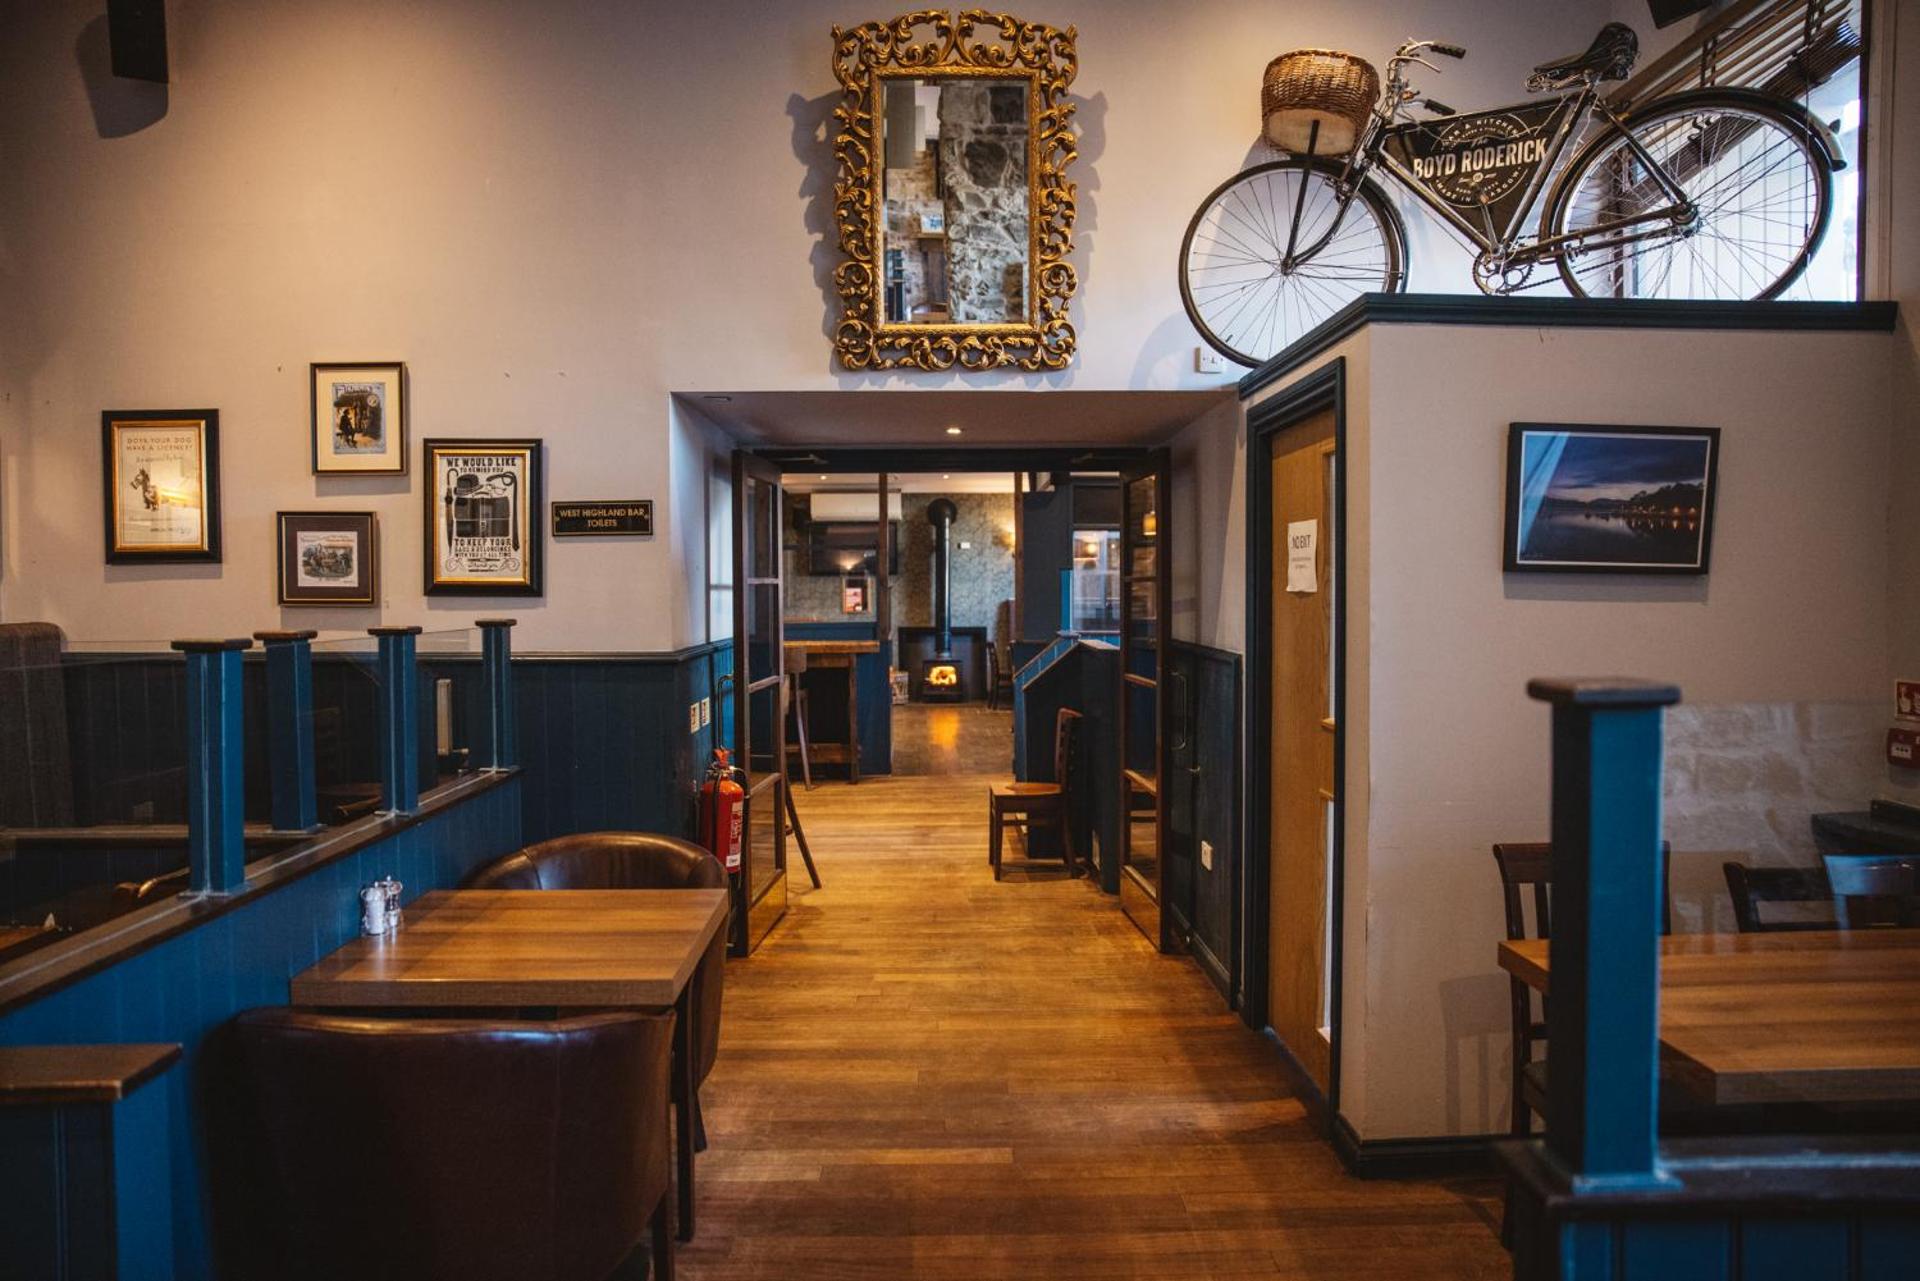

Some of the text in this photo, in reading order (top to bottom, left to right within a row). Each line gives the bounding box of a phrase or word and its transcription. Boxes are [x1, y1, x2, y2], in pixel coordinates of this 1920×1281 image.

[1476, 119, 1520, 138] KITCHEN
[1413, 137, 1548, 179] BOYD RODERICK
[446, 458, 517, 467] WE WOULD LIKE
[559, 507, 645, 518] WEST HIGHLAND BAR
[587, 519, 618, 527] TOILETS
[454, 538, 512, 546] TO KEEP YOUR
[1300, 534, 1311, 549] EXIT
